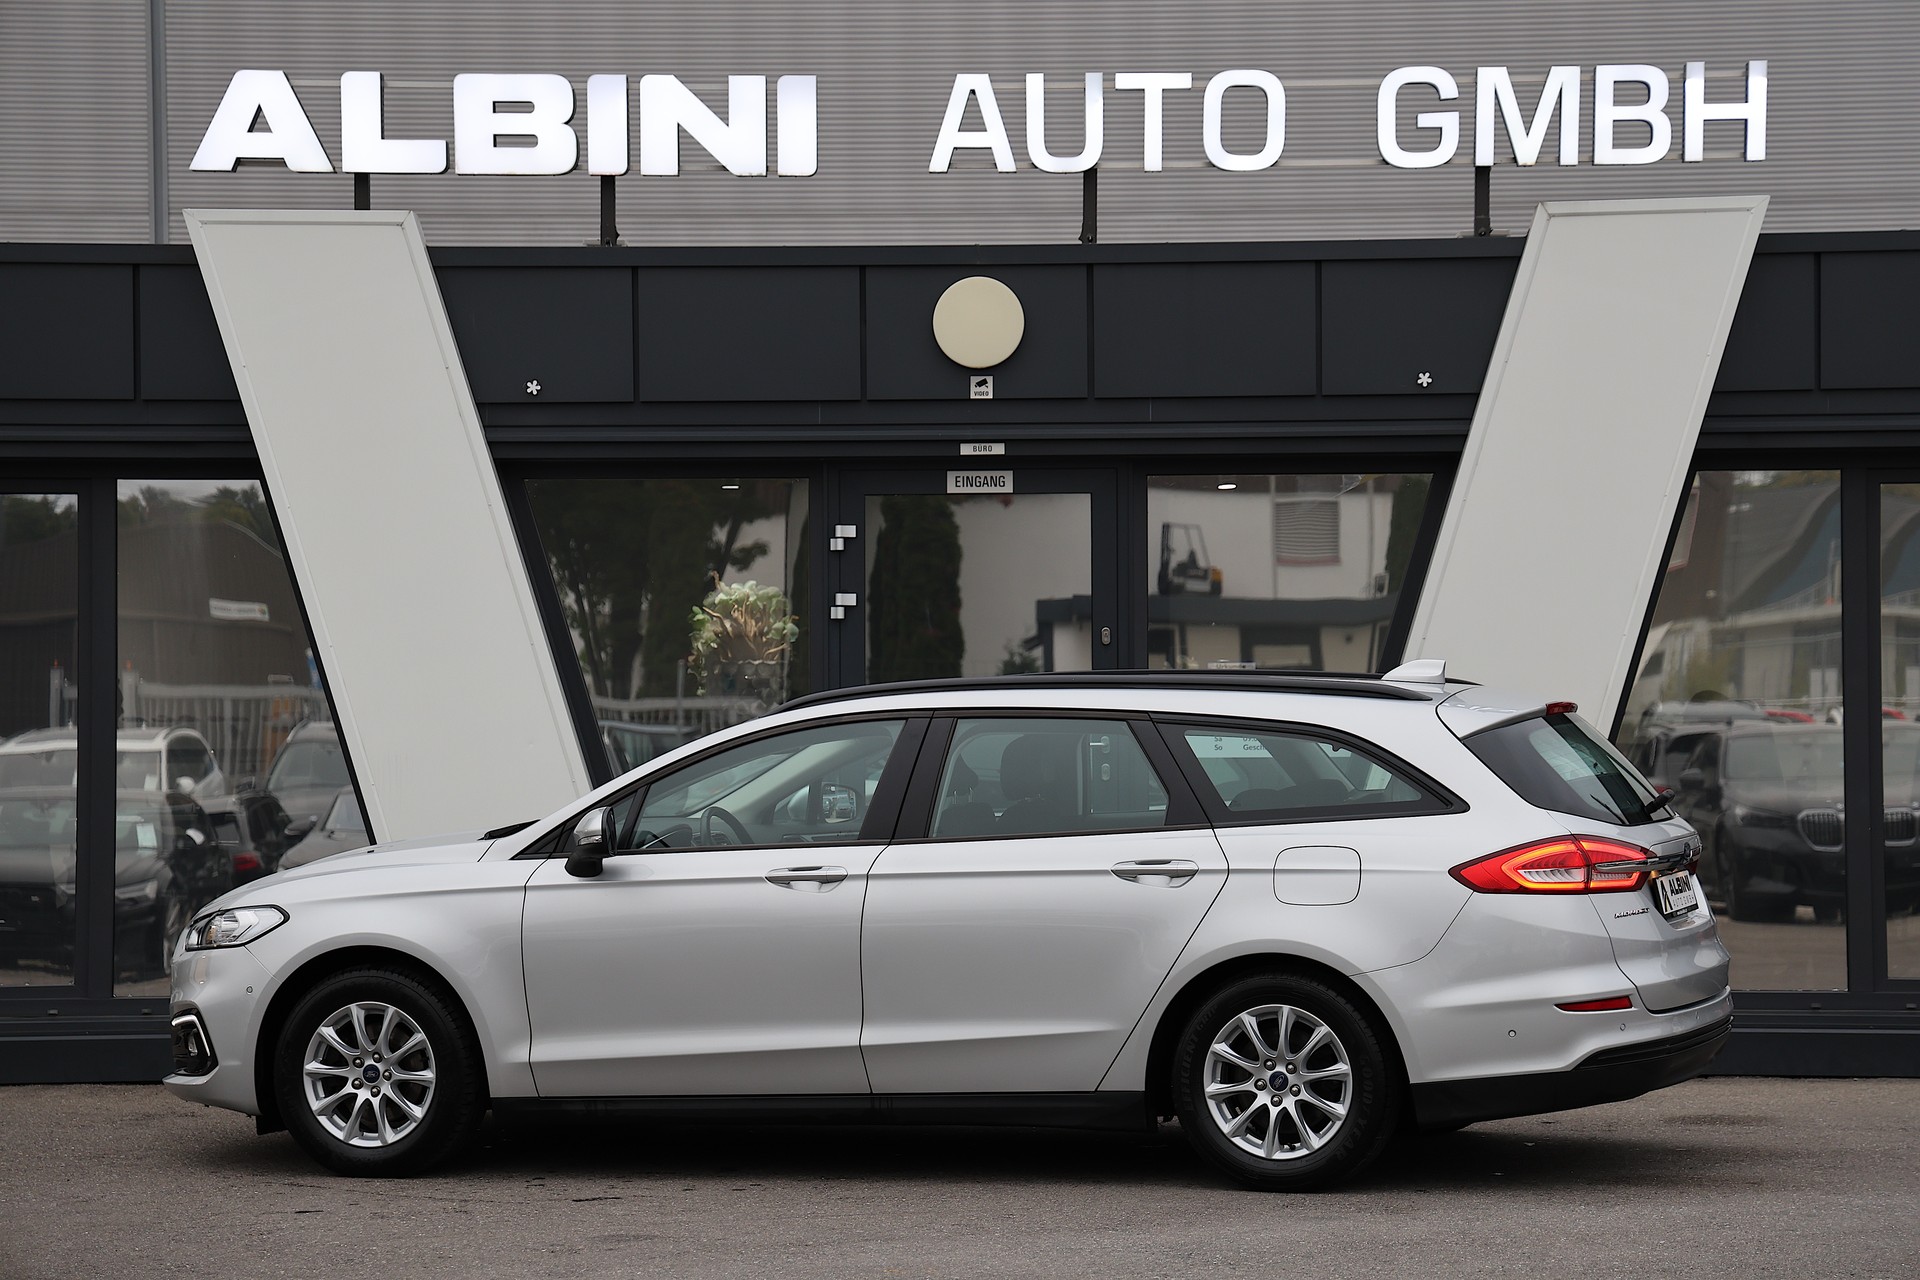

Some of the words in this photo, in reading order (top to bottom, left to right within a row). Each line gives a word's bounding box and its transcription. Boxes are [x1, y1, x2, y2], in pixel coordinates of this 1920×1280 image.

[189, 69, 819, 177] ALBINI
[928, 69, 1286, 173] AUTO
[1376, 60, 1768, 168] GMBH
[972, 444, 993, 453] BÜRO
[954, 475, 1006, 488] EINGANG
[1668, 875, 1692, 897] ALBINI
